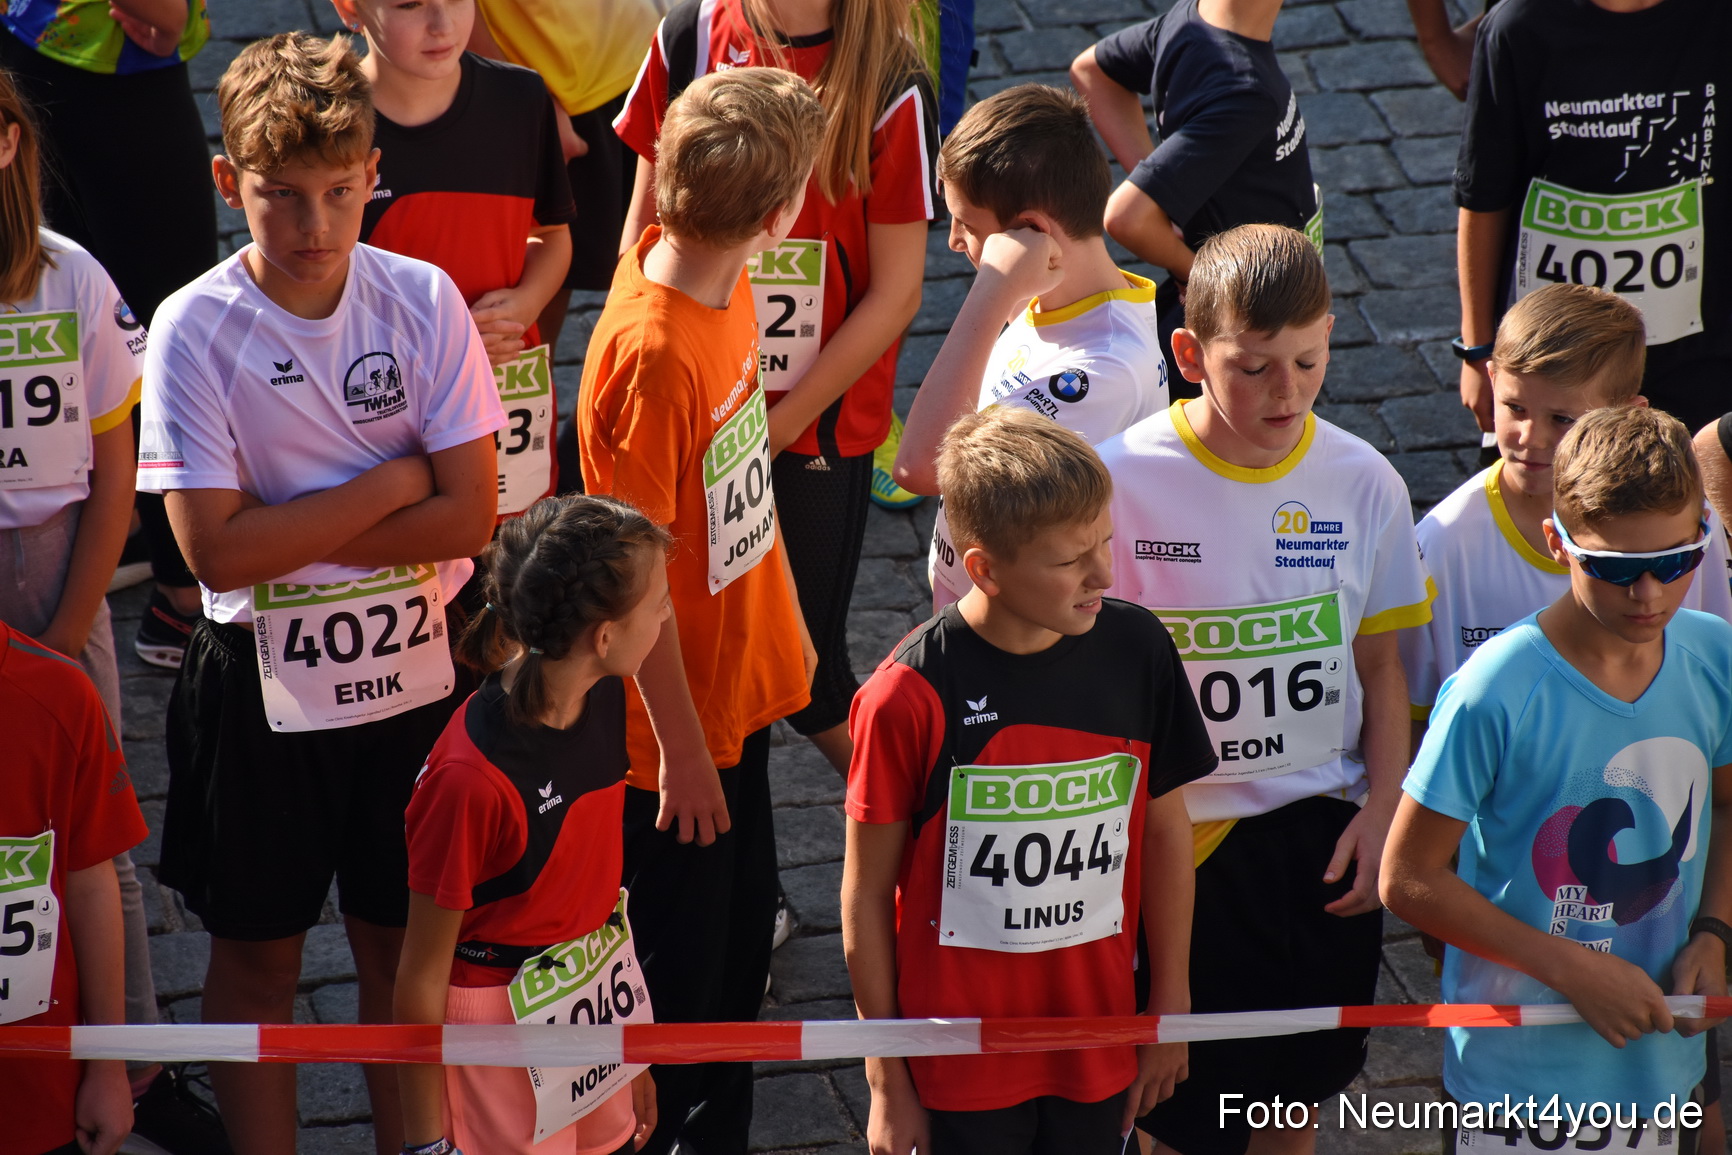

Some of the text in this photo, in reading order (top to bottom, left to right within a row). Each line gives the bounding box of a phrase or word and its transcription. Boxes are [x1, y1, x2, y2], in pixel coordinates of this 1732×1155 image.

[1544, 92, 1666, 119] Neumarkter
[1548, 116, 1642, 139] Stadtlauf
[1533, 190, 1689, 236] BOCK
[1536, 243, 1685, 293] 4020
[757, 294, 796, 338] 2
[66, 376, 74, 386] J
[270, 374, 304, 386] erima
[539, 409, 546, 418] J
[1029, 388, 1059, 420] PARTL
[496, 408, 532, 455] 3
[1276, 510, 1340, 534] 20 JAHRE
[1135, 540, 1201, 558] BOCK
[1275, 538, 1350, 551] Neumarkter
[1274, 554, 1336, 570] Stadtlauf
[432, 592, 438, 602] J
[283, 595, 431, 668] 4022
[1161, 602, 1329, 655] BOCK
[1329, 661, 1337, 671] J
[334, 672, 404, 705] ERIK
[963, 712, 998, 726] erima
[1216, 734, 1284, 762] EON
[966, 761, 1120, 815] BOCK
[538, 795, 562, 814] erima
[1115, 822, 1122, 832] J
[969, 823, 1113, 887] 4044
[1557, 887, 1585, 901] MY
[42, 901, 49, 911] J
[1004, 900, 1084, 930] LINUS
[1554, 903, 1611, 921] HEART
[1551, 920, 1566, 934] IS
[626, 957, 632, 967] J
[547, 961, 635, 1025] 046
